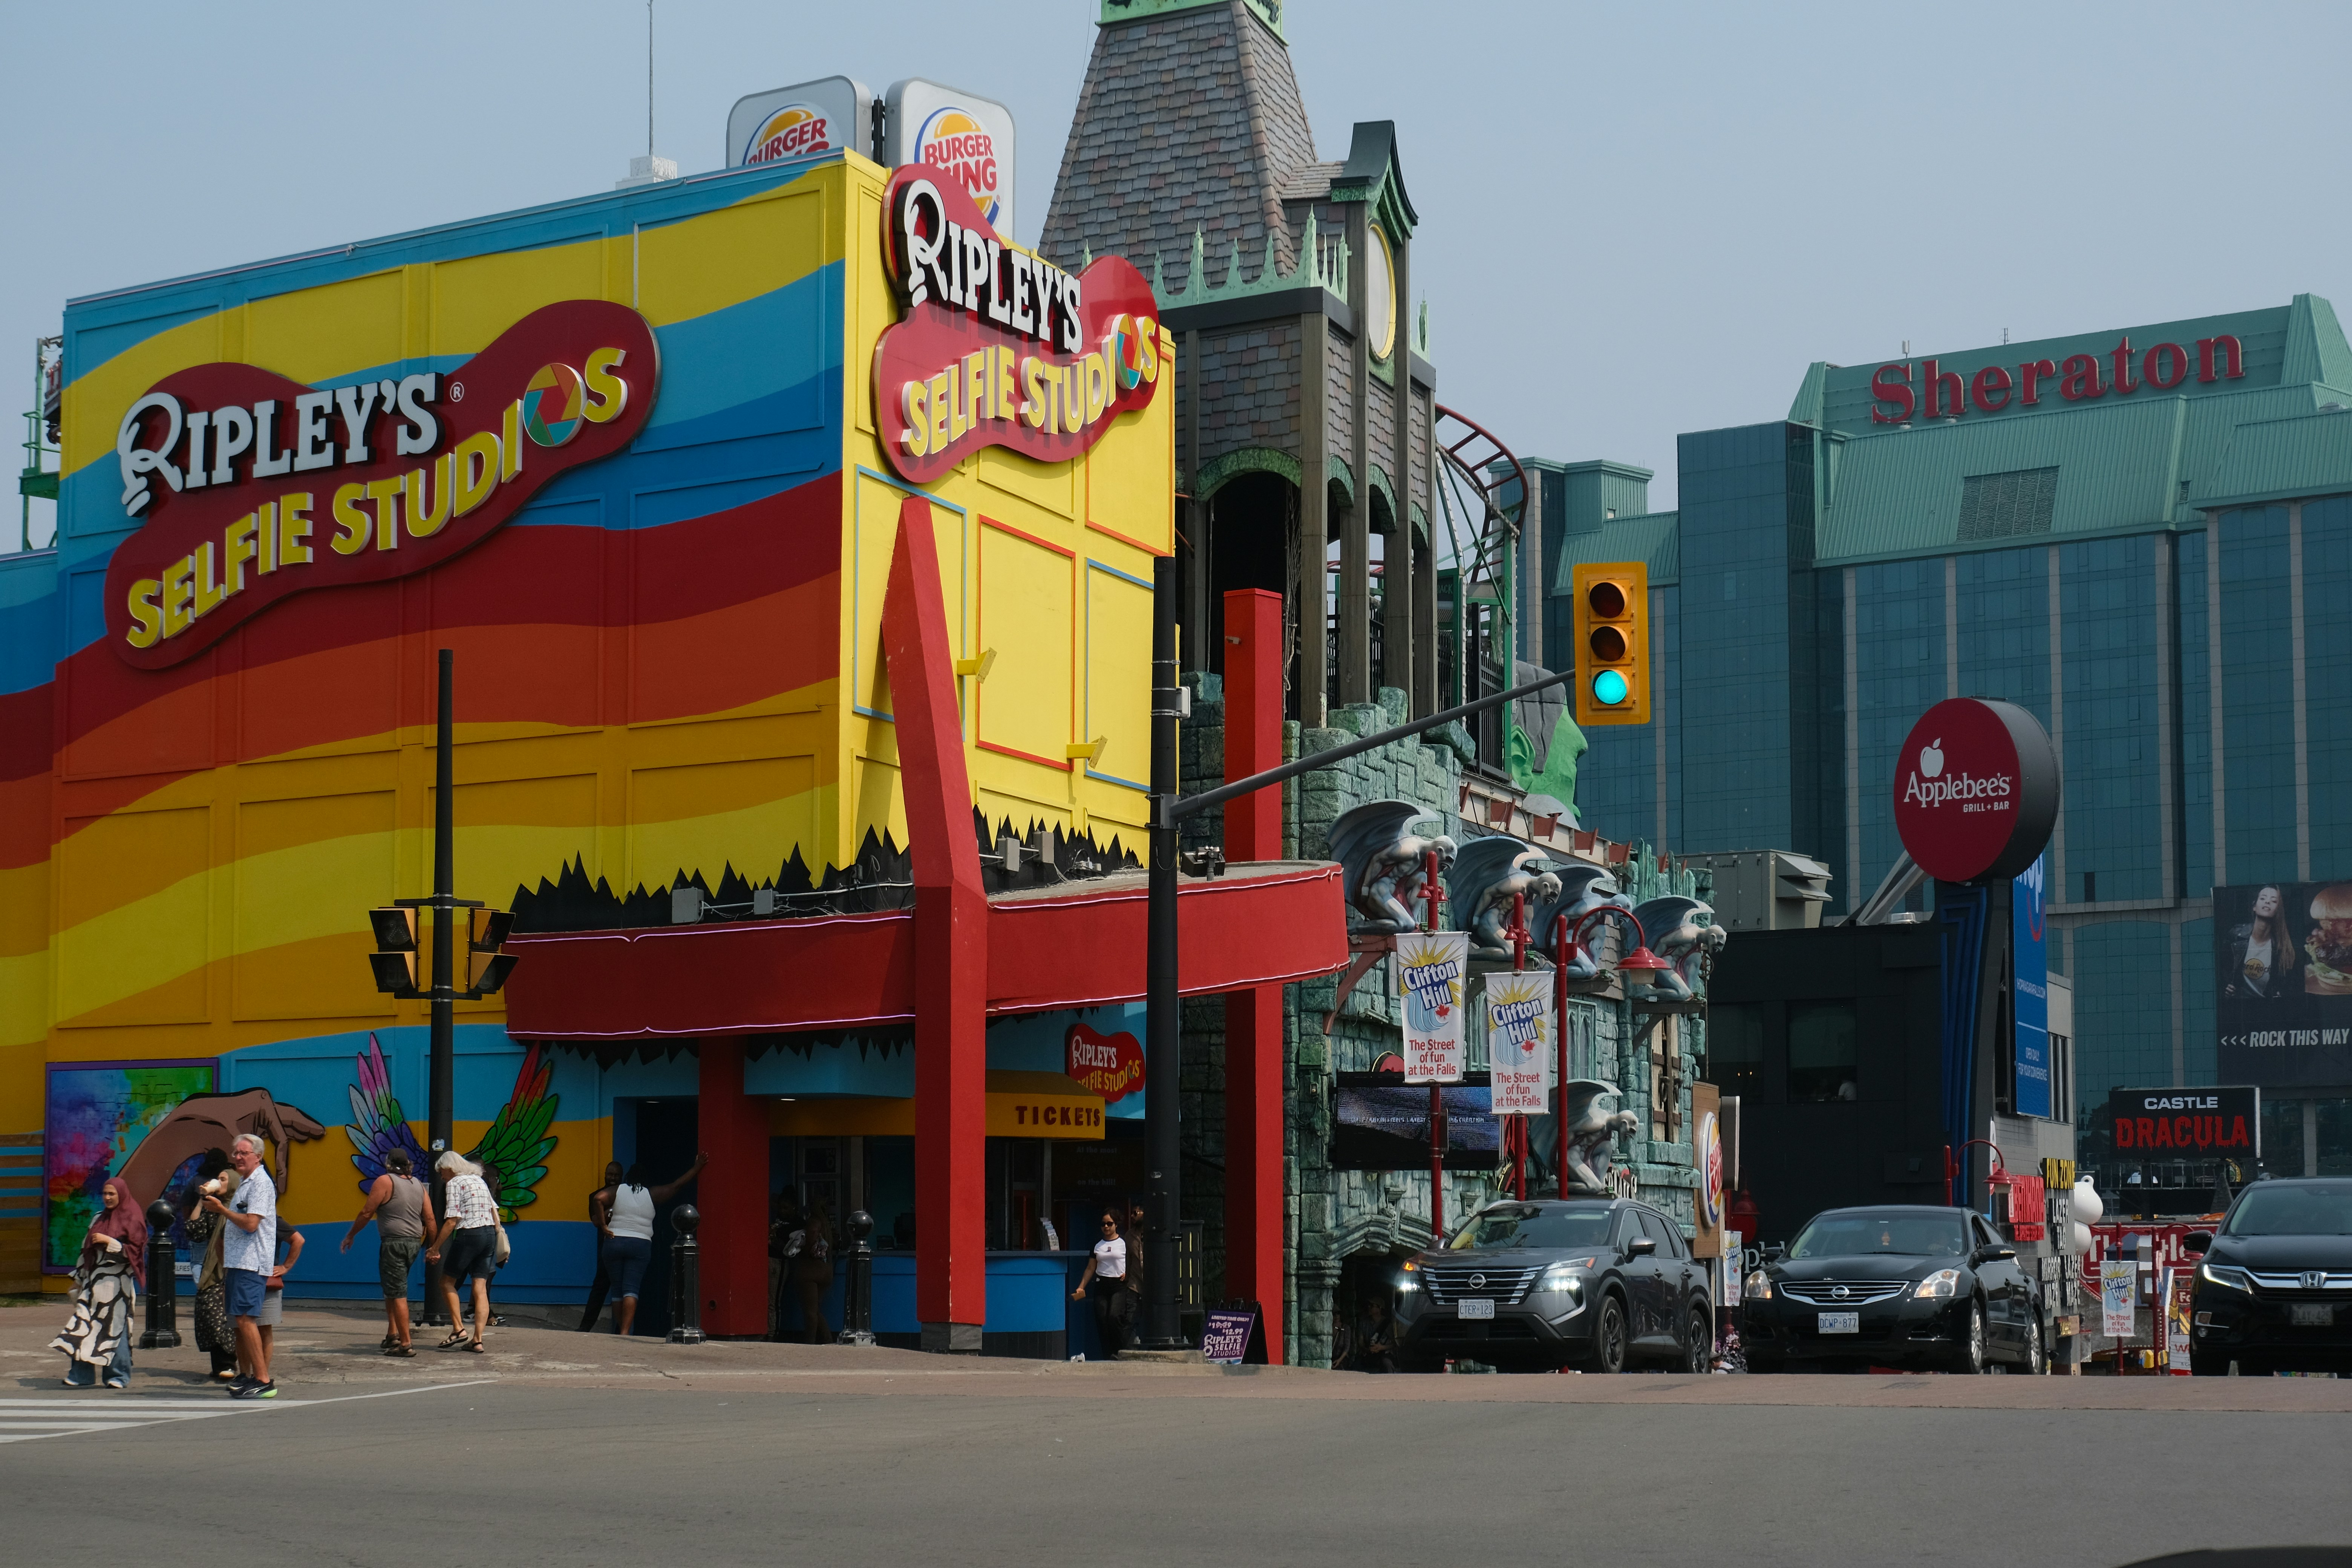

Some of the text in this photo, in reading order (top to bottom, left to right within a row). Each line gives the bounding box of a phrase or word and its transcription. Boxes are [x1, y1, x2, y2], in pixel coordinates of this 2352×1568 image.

[925, 135, 993, 166] BURGER
[944, 158, 997, 193] ING
[904, 179, 1083, 354] RIPLEY'S
[901, 314, 1156, 457] SELFIE STUDIOS
[1871, 335, 2245, 425] Sheraton
[116, 372, 437, 516] RIPLEY'S
[126, 347, 627, 648] SELFIE STUDIOS
[1903, 771, 2011, 808] Applebee's
[1963, 802, 1985, 813] GRILL
[1994, 801, 2009, 811] BAR
[1403, 960, 1459, 991] Clifton
[1421, 983, 1453, 1011] Hill
[1491, 998, 1544, 1027] Clifton
[1409, 1039, 1455, 1051] The Street
[1508, 1020, 1539, 1046] Hill
[2249, 1028, 2350, 1047] ROCK THIS WAY
[1072, 1035, 1117, 1069] RIPLEY'S
[1419, 1051, 1445, 1063] of fun
[1104, 1060, 1140, 1092] STUDIOS
[1408, 1064, 1456, 1075] at the Falls
[1496, 1072, 1540, 1084] The Street
[1495, 1095, 1541, 1107] at the Falls
[1506, 1084, 1530, 1095] of fun
[2144, 1096, 2218, 1110] CASTLE
[1015, 1106, 1101, 1127] TICKETS
[2115, 1115, 2249, 1152] DRACULA
[2046, 1158, 2075, 1190] FUN ZONE
[2052, 1198, 2069, 1223] LAZER
[2056, 1226, 2066, 1250] TAG
[1725, 1245, 1741, 1260] Clifton
[1729, 1256, 1738, 1269] Hill
[2041, 1256, 2061, 1281] MIRROR
[2064, 1254, 2081, 1279] LAZER
[2044, 1282, 2059, 1310] MAZE
[2066, 1280, 2081, 1307] MAZE
[2104, 1276, 2133, 1291] Clifton
[2112, 1286, 2129, 1300] Hill
[1460, 1305, 1493, 1314] CTER 123
[1820, 1318, 1857, 1328] DCWP 877
[1204, 1334, 1242, 1346] RIPLEY'S
[1214, 1343, 1241, 1351] SELFIE
